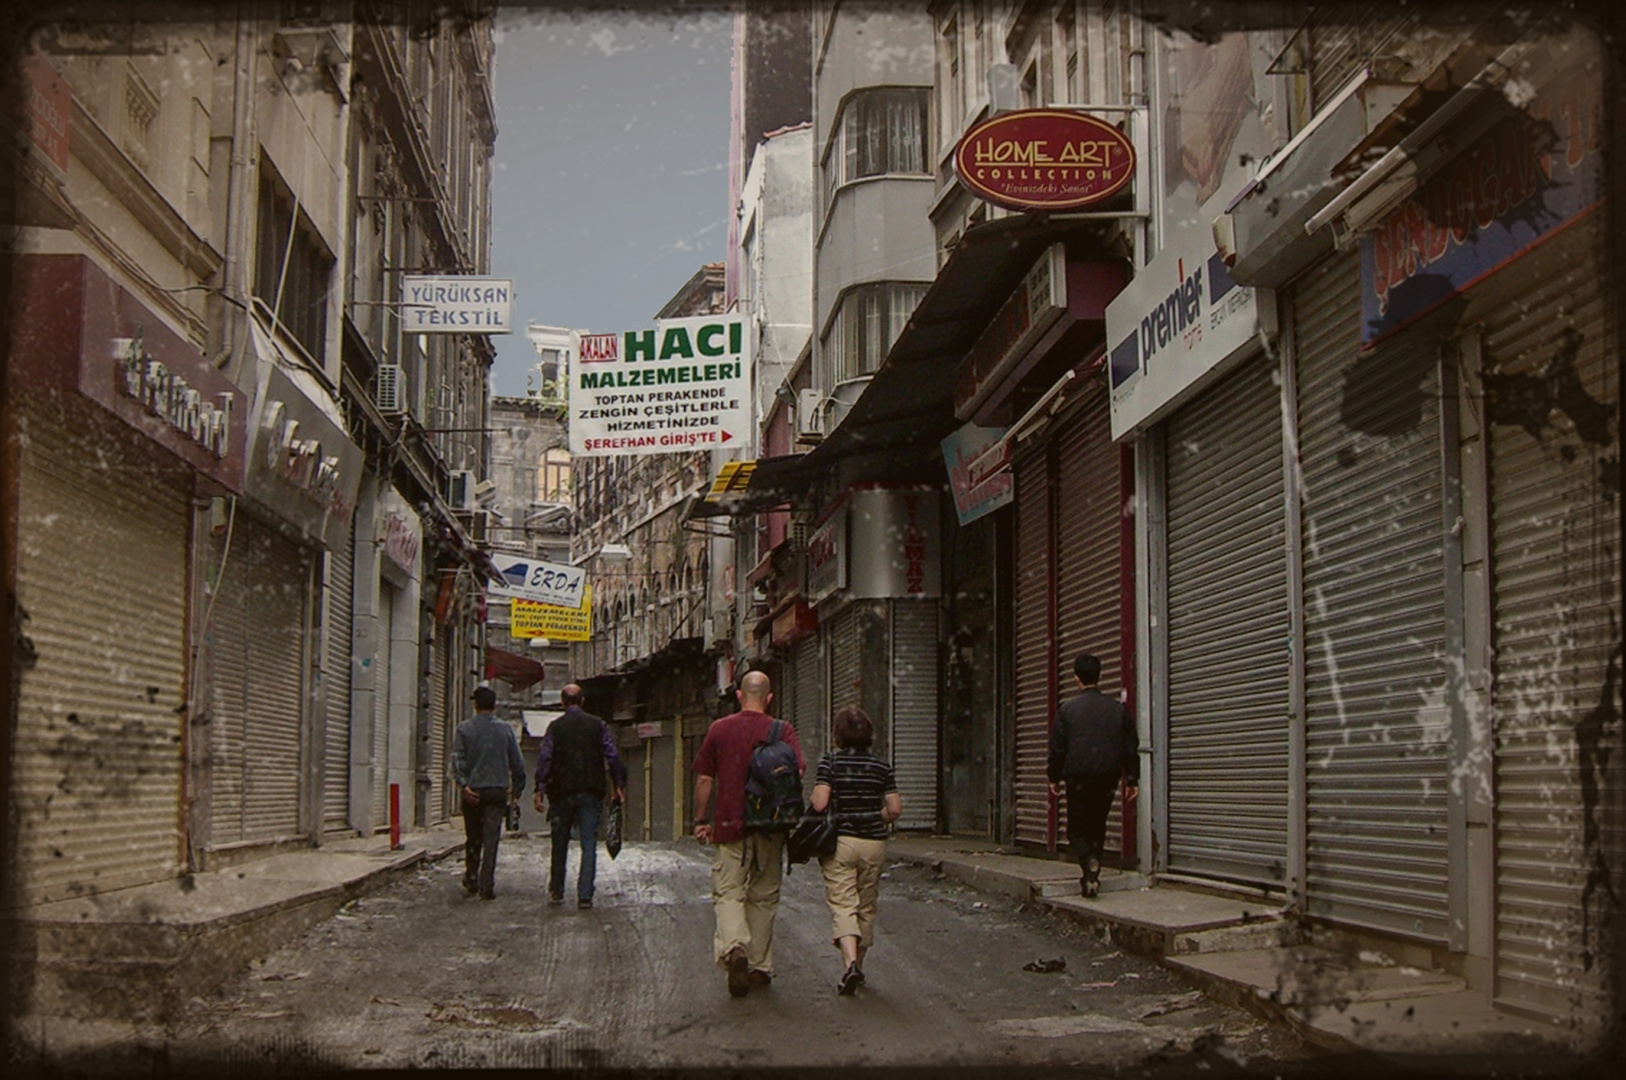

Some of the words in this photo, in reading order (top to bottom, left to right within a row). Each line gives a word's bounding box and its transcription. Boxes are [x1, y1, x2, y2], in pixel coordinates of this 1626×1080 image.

[975, 137, 1054, 167] HOME
[1059, 141, 1118, 167] ART
[976, 168, 1112, 180] COLLECTION
[411, 283, 508, 304] YÜRÜKSAN
[415, 308, 503, 325] TEKSTİL
[1141, 258, 1202, 376] premier
[580, 337, 617, 360] AKALAN
[624, 322, 742, 363] HACI
[580, 357, 741, 389] MALZEMELERİ
[594, 393, 644, 406] TOPTAN
[648, 387, 726, 402] PERAKENDE
[578, 406, 638, 419] ZENGİN
[643, 399, 739, 418] ÇEŞİTLERLE
[607, 416, 719, 432] HİZMETİNİZDE
[584, 436, 655, 451] ŞEREFHAN
[660, 431, 716, 446] GİRİŞ'TE
[531, 566, 581, 593] ERDA
